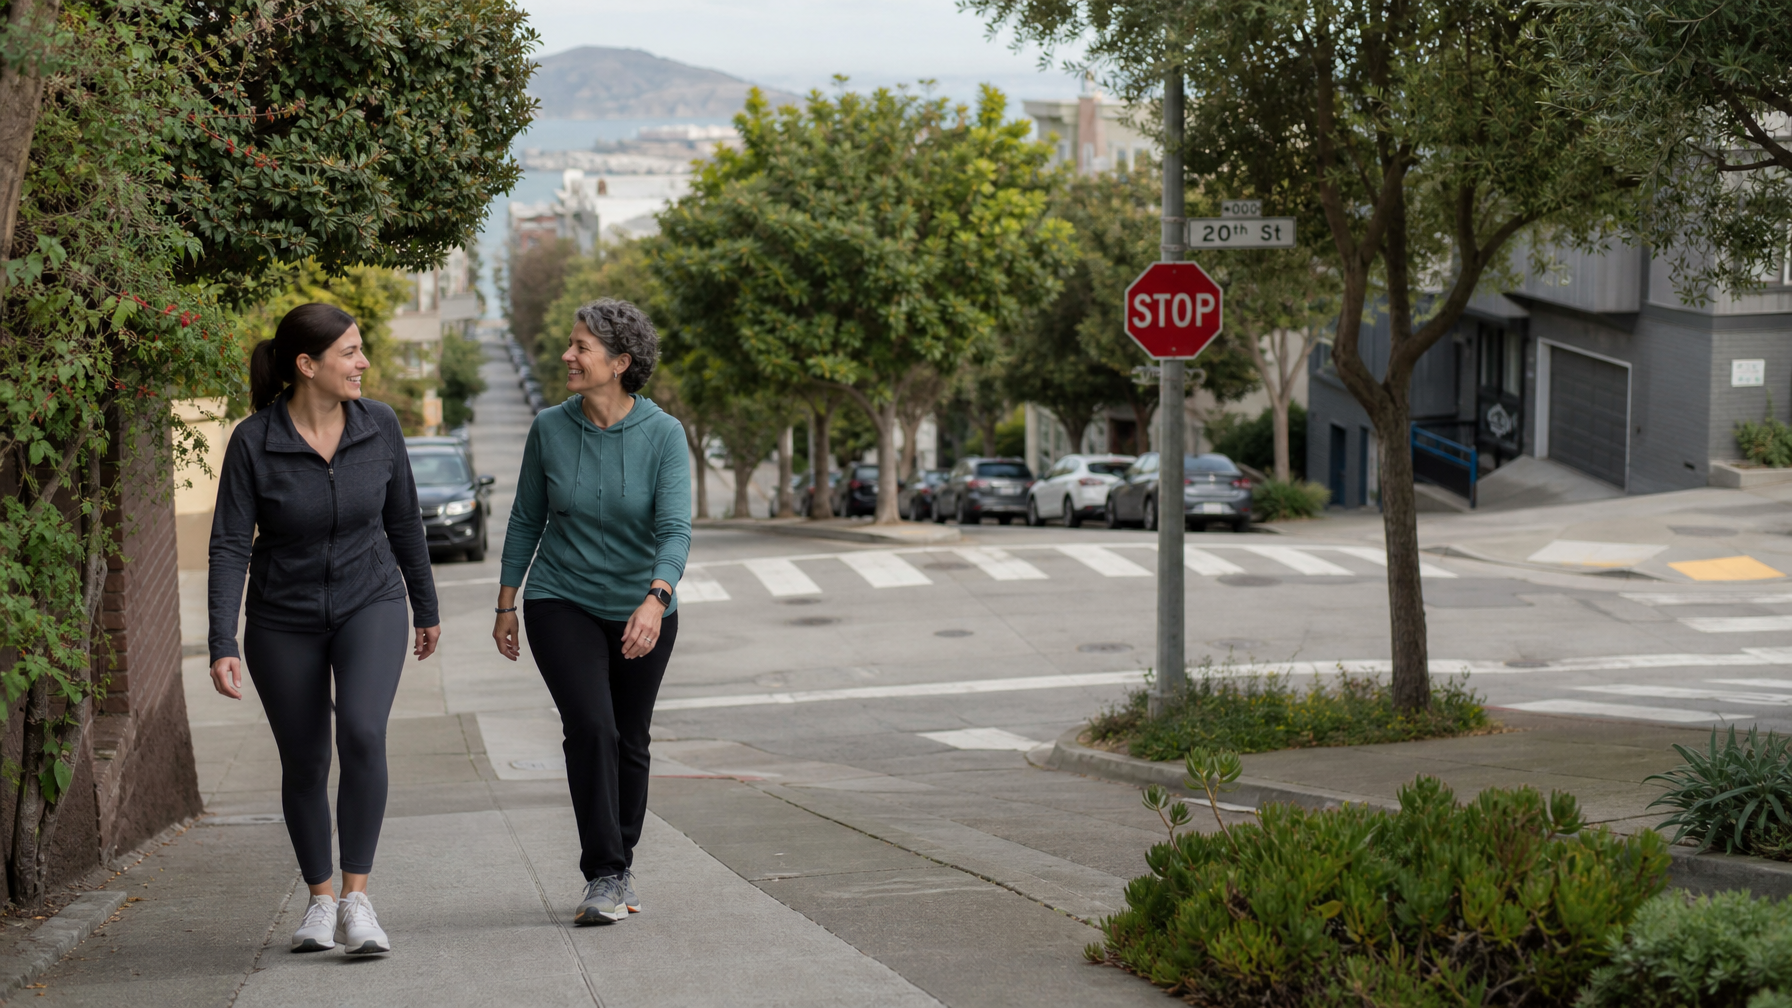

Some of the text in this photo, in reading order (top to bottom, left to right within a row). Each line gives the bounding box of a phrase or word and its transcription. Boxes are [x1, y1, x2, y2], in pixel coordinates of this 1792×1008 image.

[1203, 224, 1282, 242] 20th St
[1132, 292, 1216, 328] STOP
